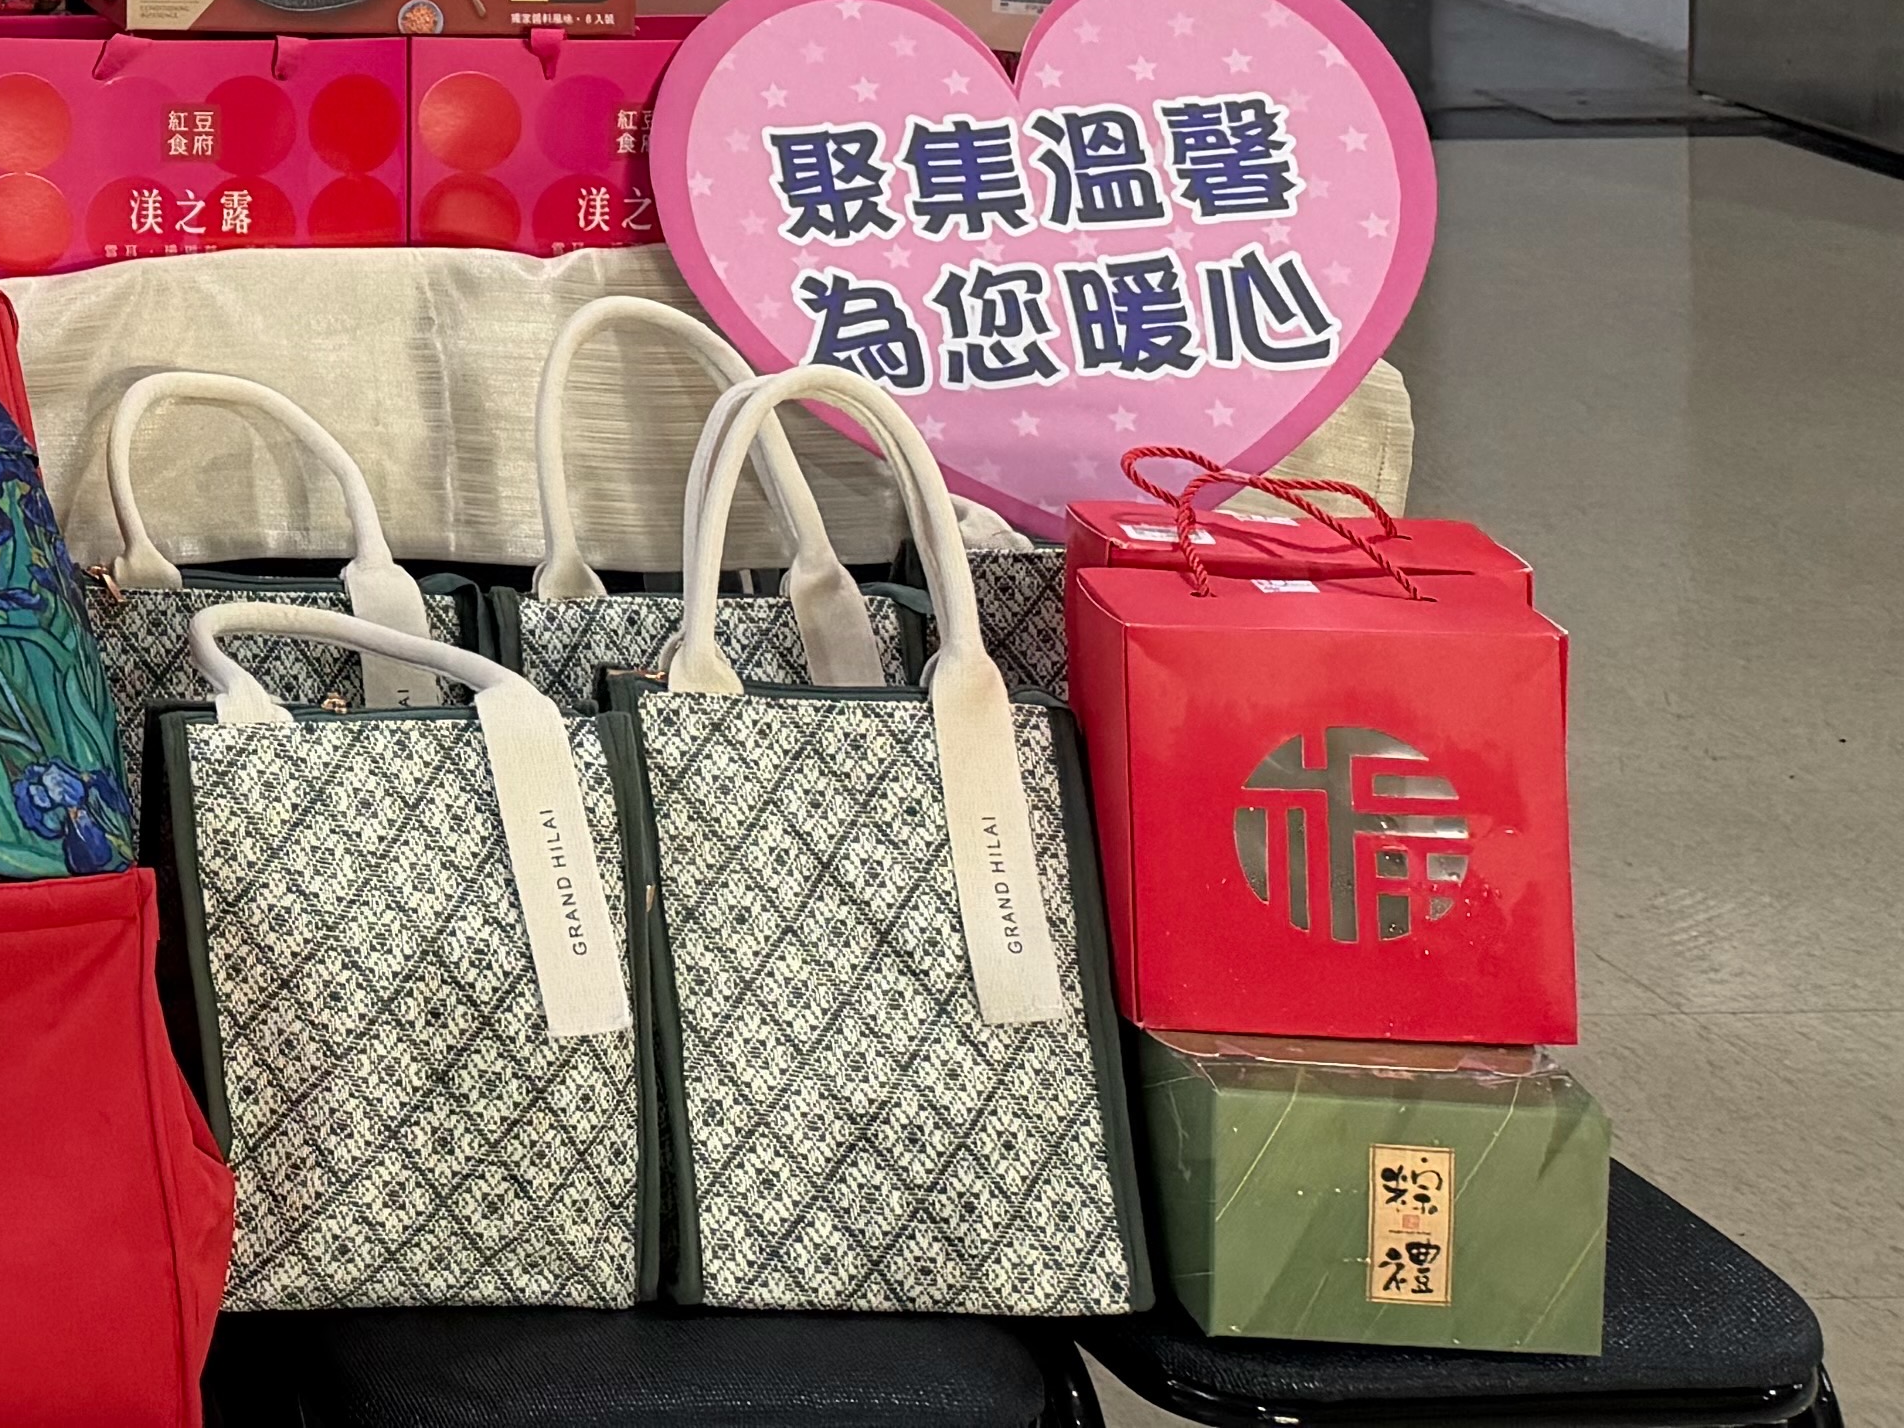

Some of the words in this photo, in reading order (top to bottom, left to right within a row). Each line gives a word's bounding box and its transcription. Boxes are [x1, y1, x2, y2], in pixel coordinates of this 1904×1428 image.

[168, 110, 215, 131] 紅豆
[168, 134, 214, 156] 食府
[768, 99, 1300, 239] 聚集溫馨
[801, 249, 1334, 389] 為您暖心
[539, 808, 569, 871] HILAI
[981, 814, 1005, 873] HILAI
[1234, 726, 1470, 942] 福
[555, 874, 588, 956] GRAND
[993, 878, 1024, 954] GRAND
[1377, 1156, 1444, 1297] 粽禮
